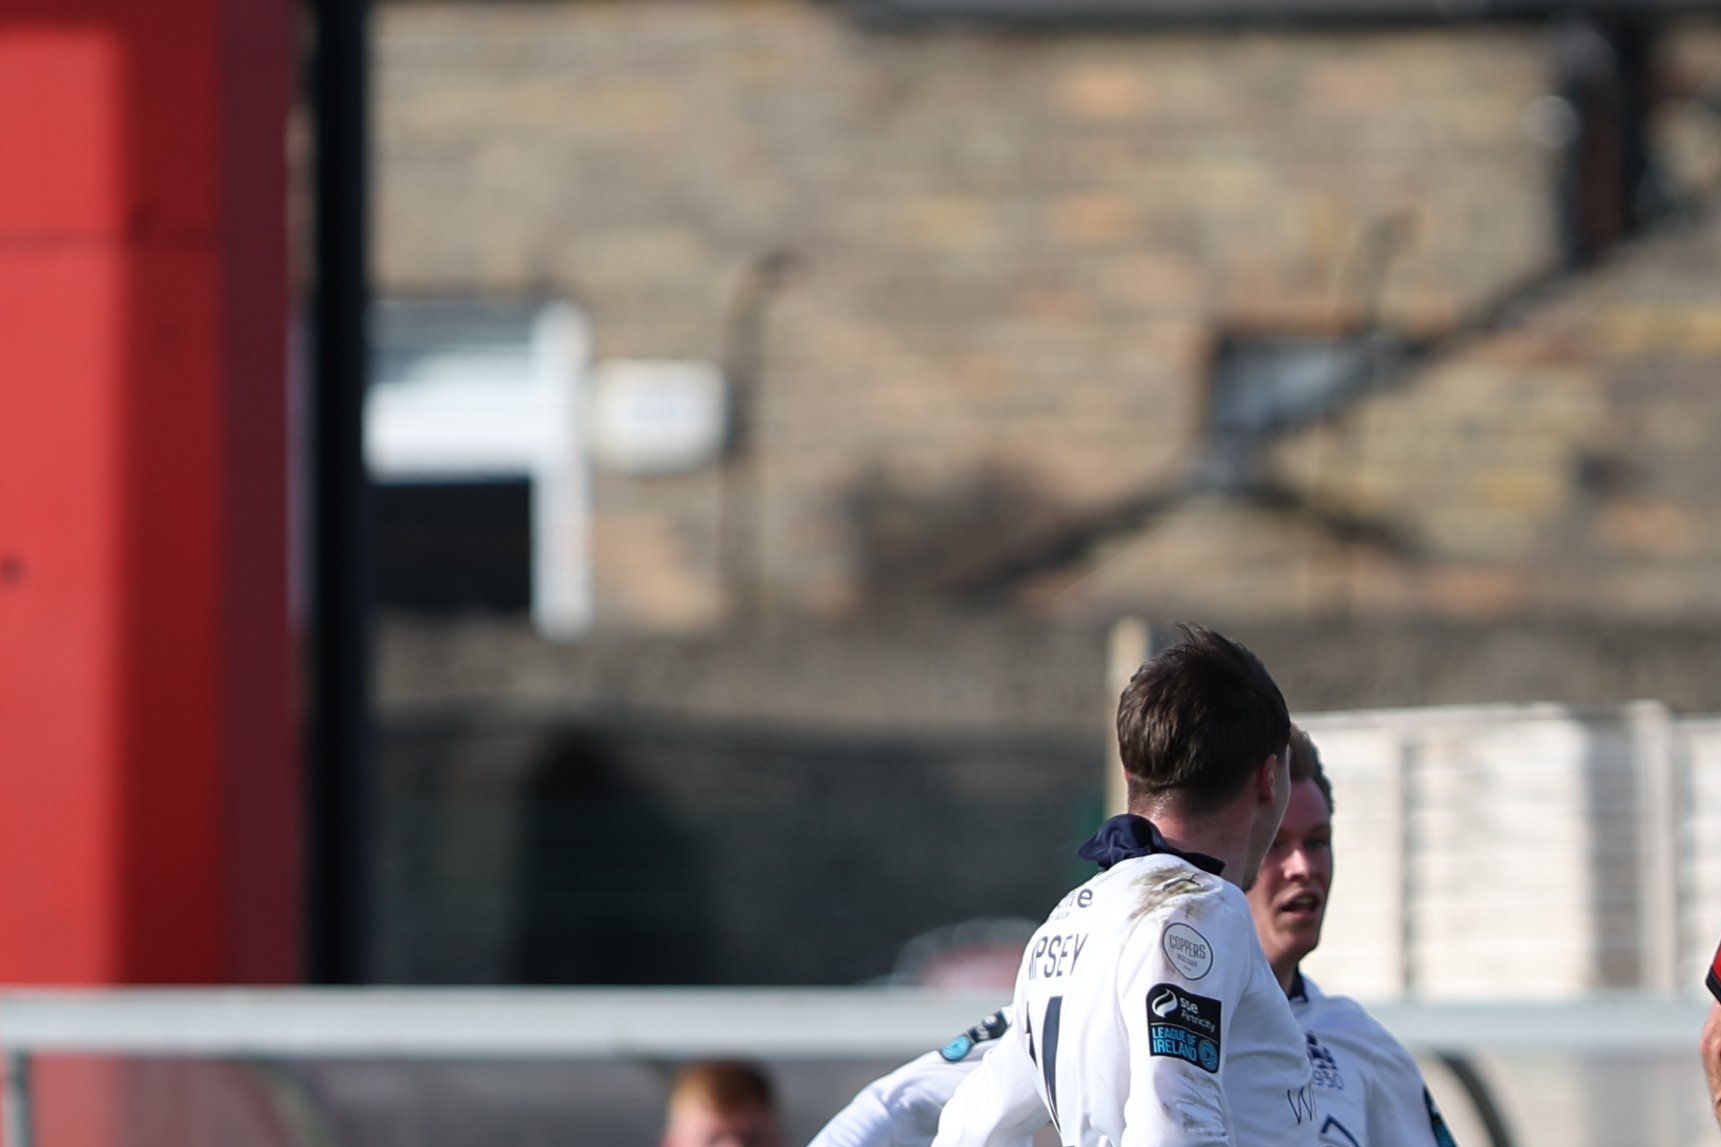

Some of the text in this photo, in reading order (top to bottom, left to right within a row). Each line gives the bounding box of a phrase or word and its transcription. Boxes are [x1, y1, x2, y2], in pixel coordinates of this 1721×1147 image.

[1169, 934, 1206, 959] COPPERS
[1152, 1026, 1186, 1042] LEAGUE
[1153, 1038, 1198, 1062] IRELAND
